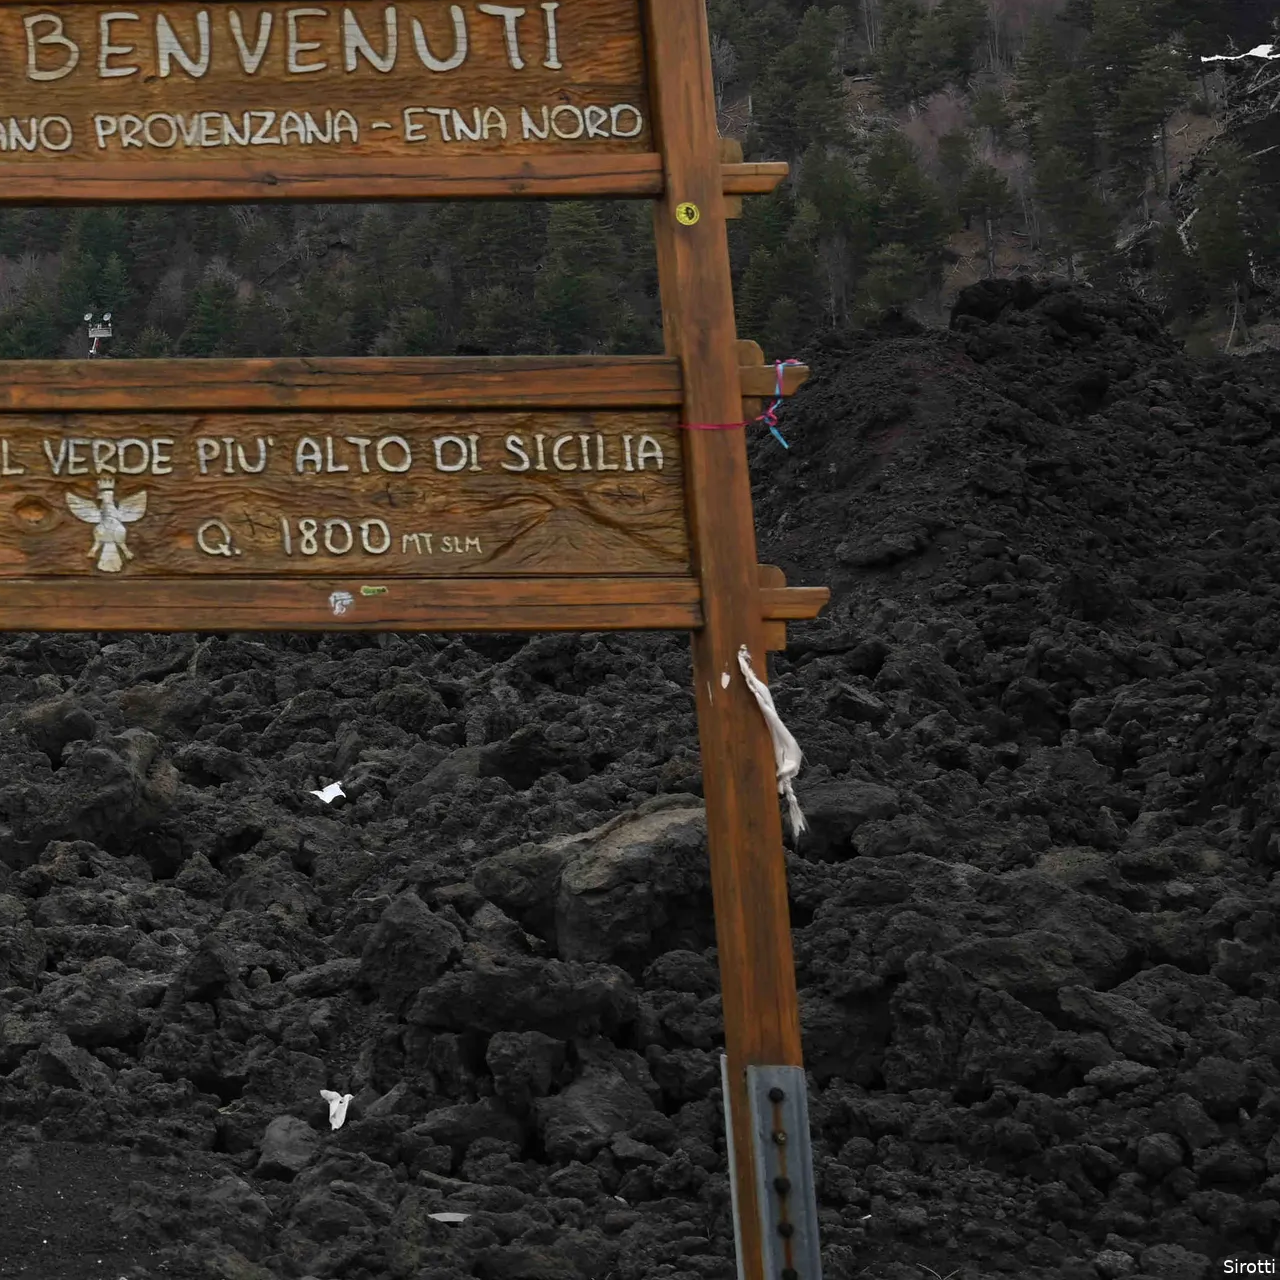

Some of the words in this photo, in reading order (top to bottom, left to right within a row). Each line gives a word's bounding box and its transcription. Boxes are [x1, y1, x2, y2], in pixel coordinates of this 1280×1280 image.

[22, 2, 563, 81] BENVENUTI
[93, 109, 359, 149] PROVENZANA
[402, 106, 508, 142] ETNA
[520, 103, 643, 140] NORD
[43, 437, 175, 476] VERDE
[294, 435, 413, 475] ALTO
[432, 434, 483, 472] DI
[500, 432, 664, 472] SICILIA
[196, 519, 241, 557] Q.
[279, 513, 391, 557] 1800
[401, 532, 433, 555] MT
[439, 534, 482, 554] SLM
